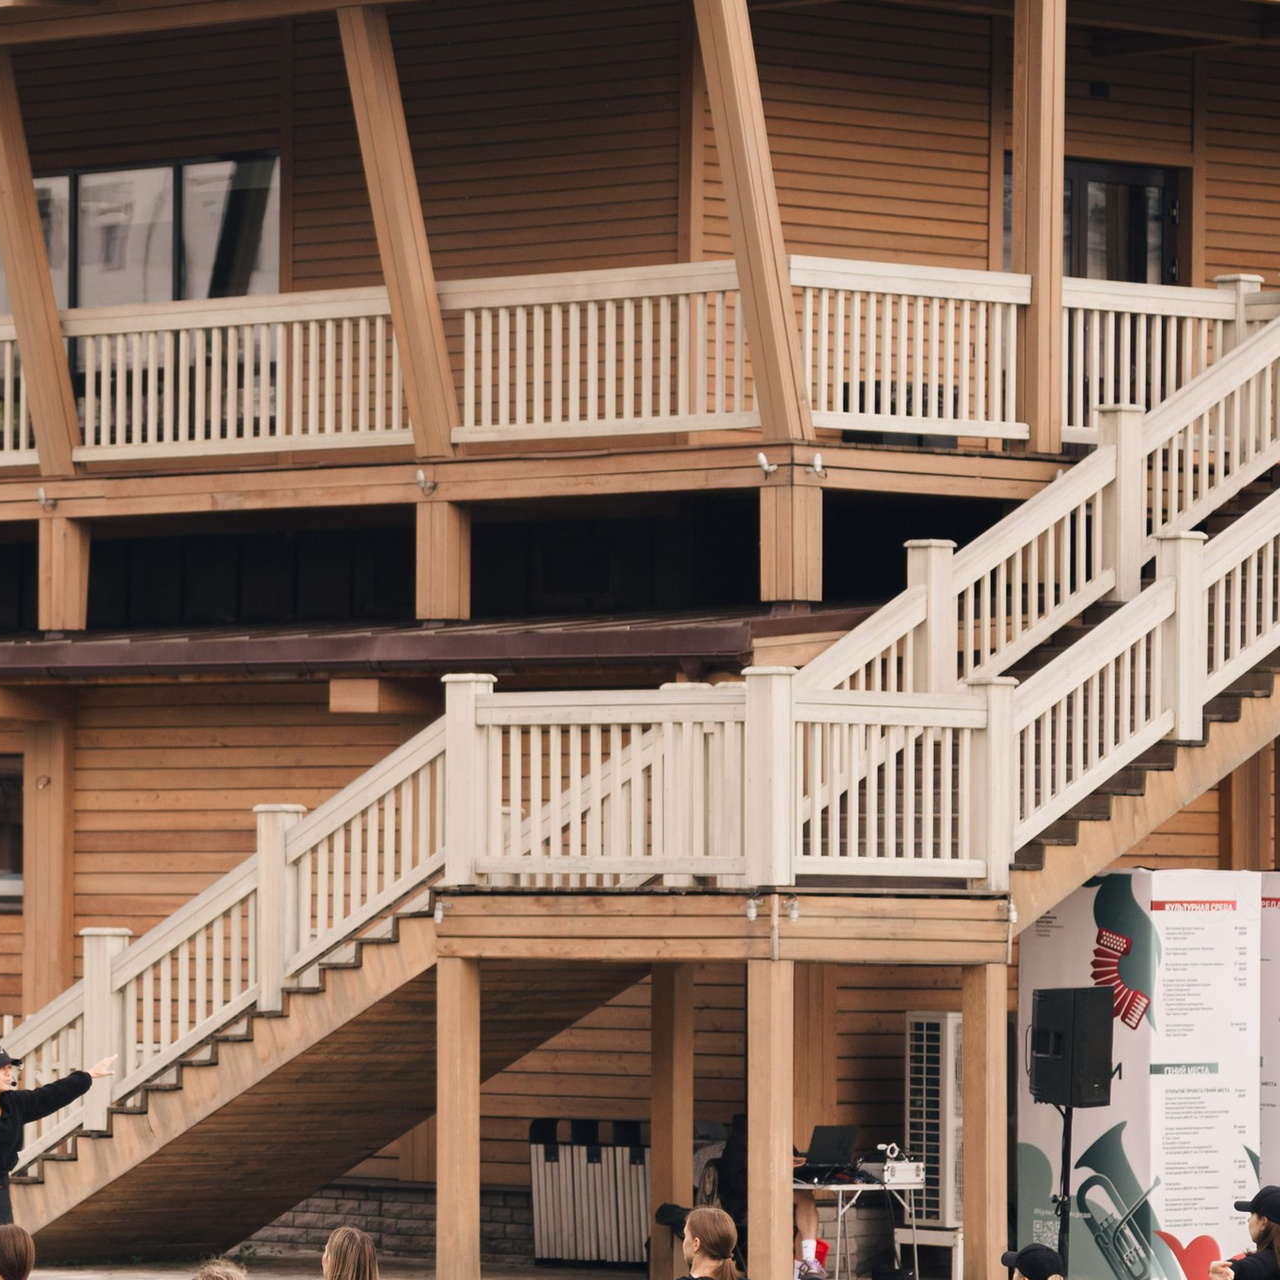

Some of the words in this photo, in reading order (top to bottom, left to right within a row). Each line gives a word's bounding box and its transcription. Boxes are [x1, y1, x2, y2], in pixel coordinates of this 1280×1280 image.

[1165, 903, 1210, 911] КУЛЬТУРНАЯ
[1211, 903, 1234, 911] СРЕДА
[1261, 900, 1280, 909] РЕДА
[1164, 1065, 1187, 1075] ГЕНИЙ
[1187, 1065, 1210, 1075] МЕСТА
